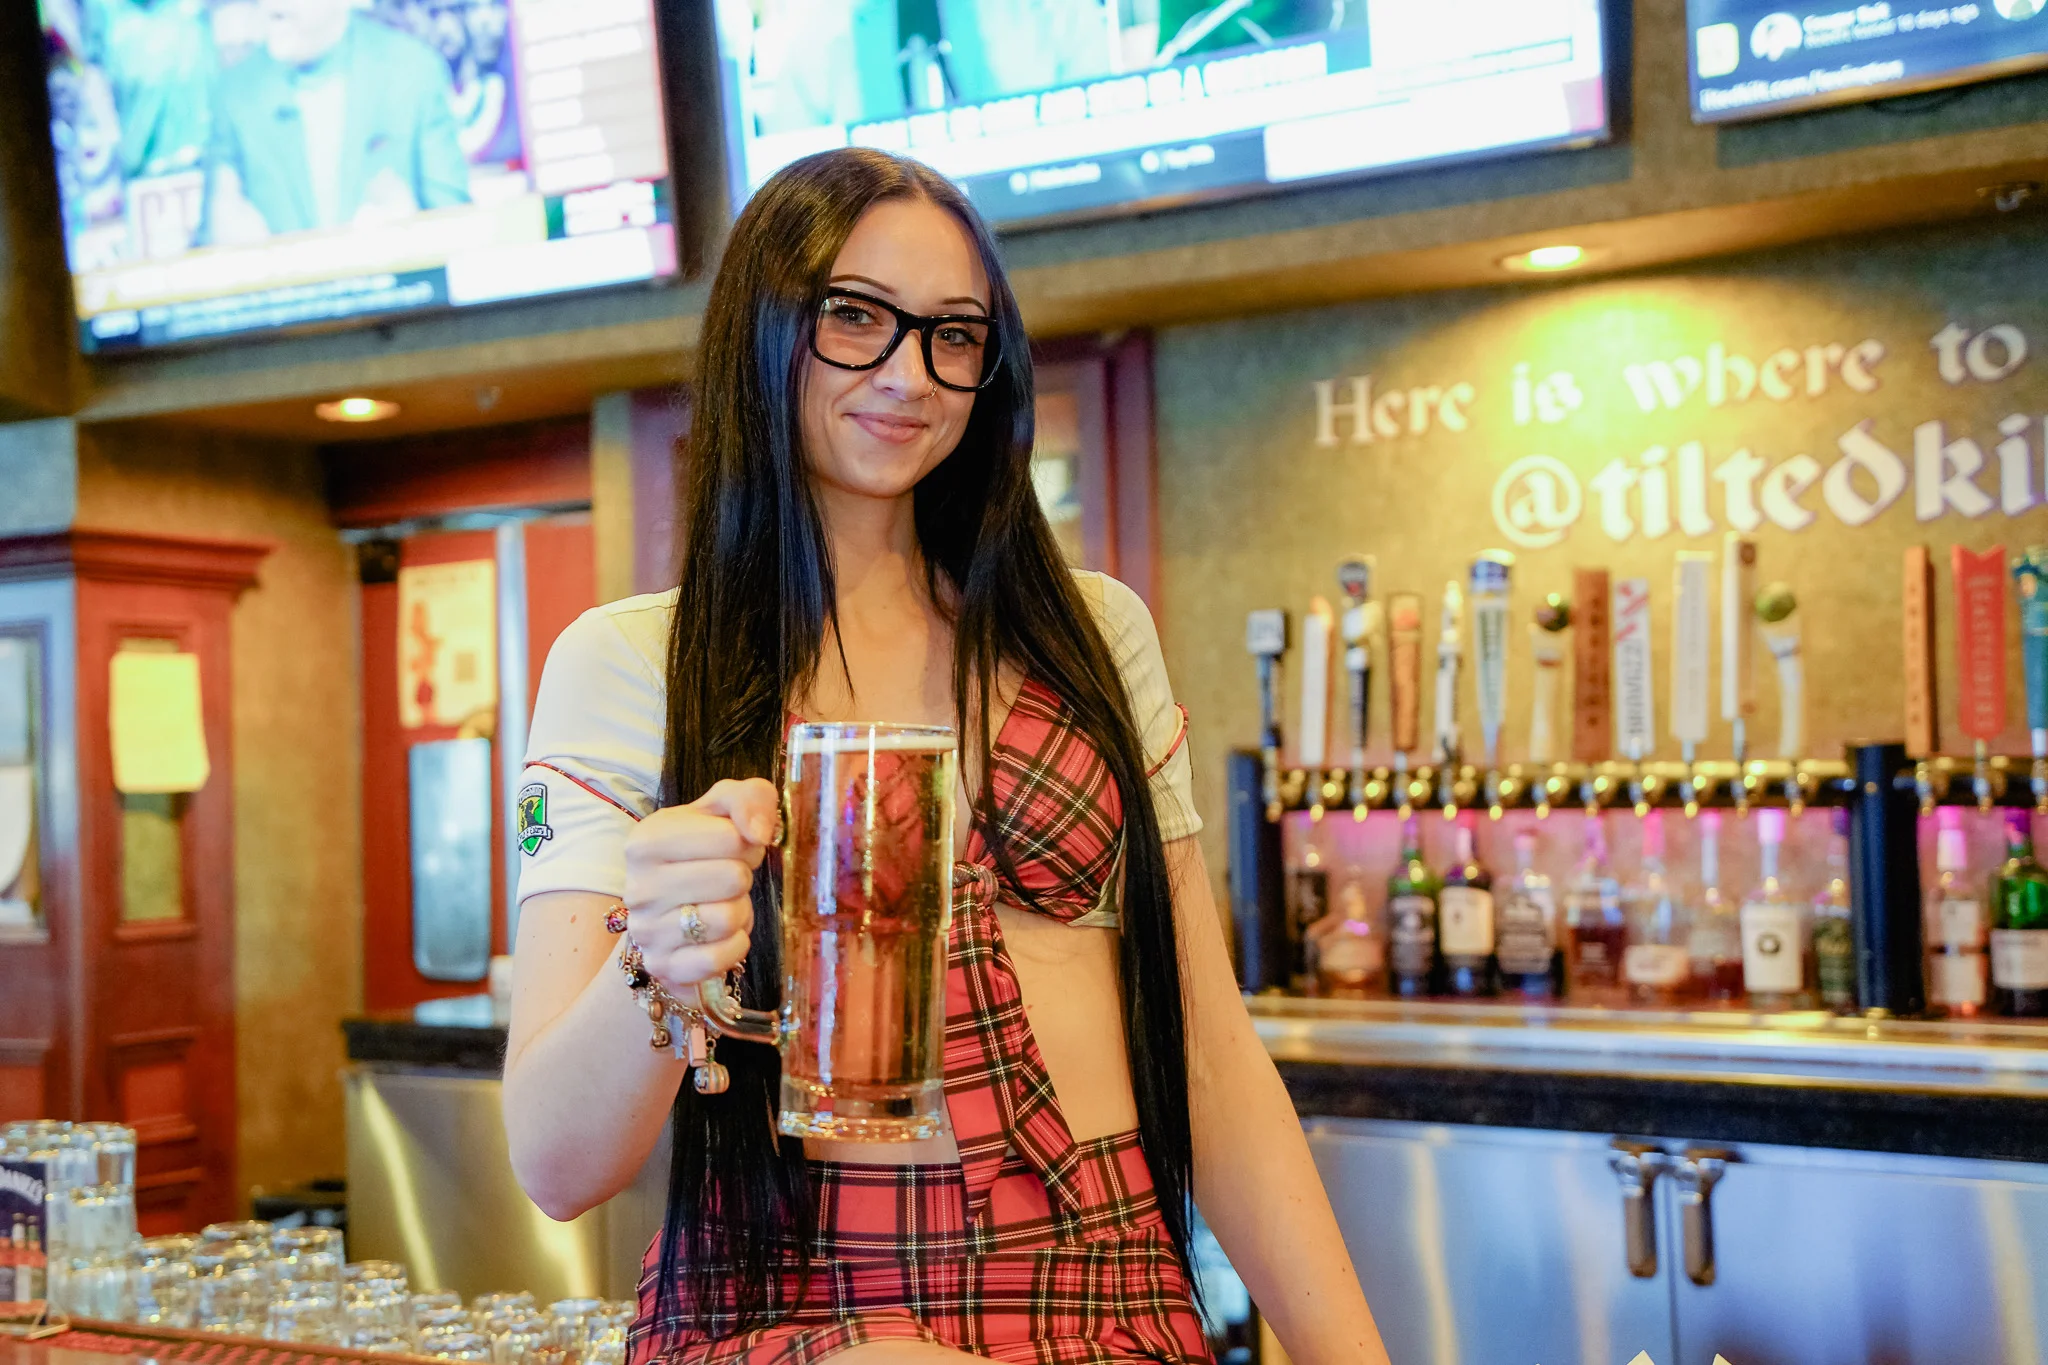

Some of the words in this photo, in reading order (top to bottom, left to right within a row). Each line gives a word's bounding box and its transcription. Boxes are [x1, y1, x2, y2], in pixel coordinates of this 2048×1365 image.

[1314, 373, 1475, 447] Here
[1511, 361, 1584, 427] is
[1623, 338, 1885, 414] where
[1930, 322, 2028, 386] to
[1491, 412, 2048, 547] @tiltedki
